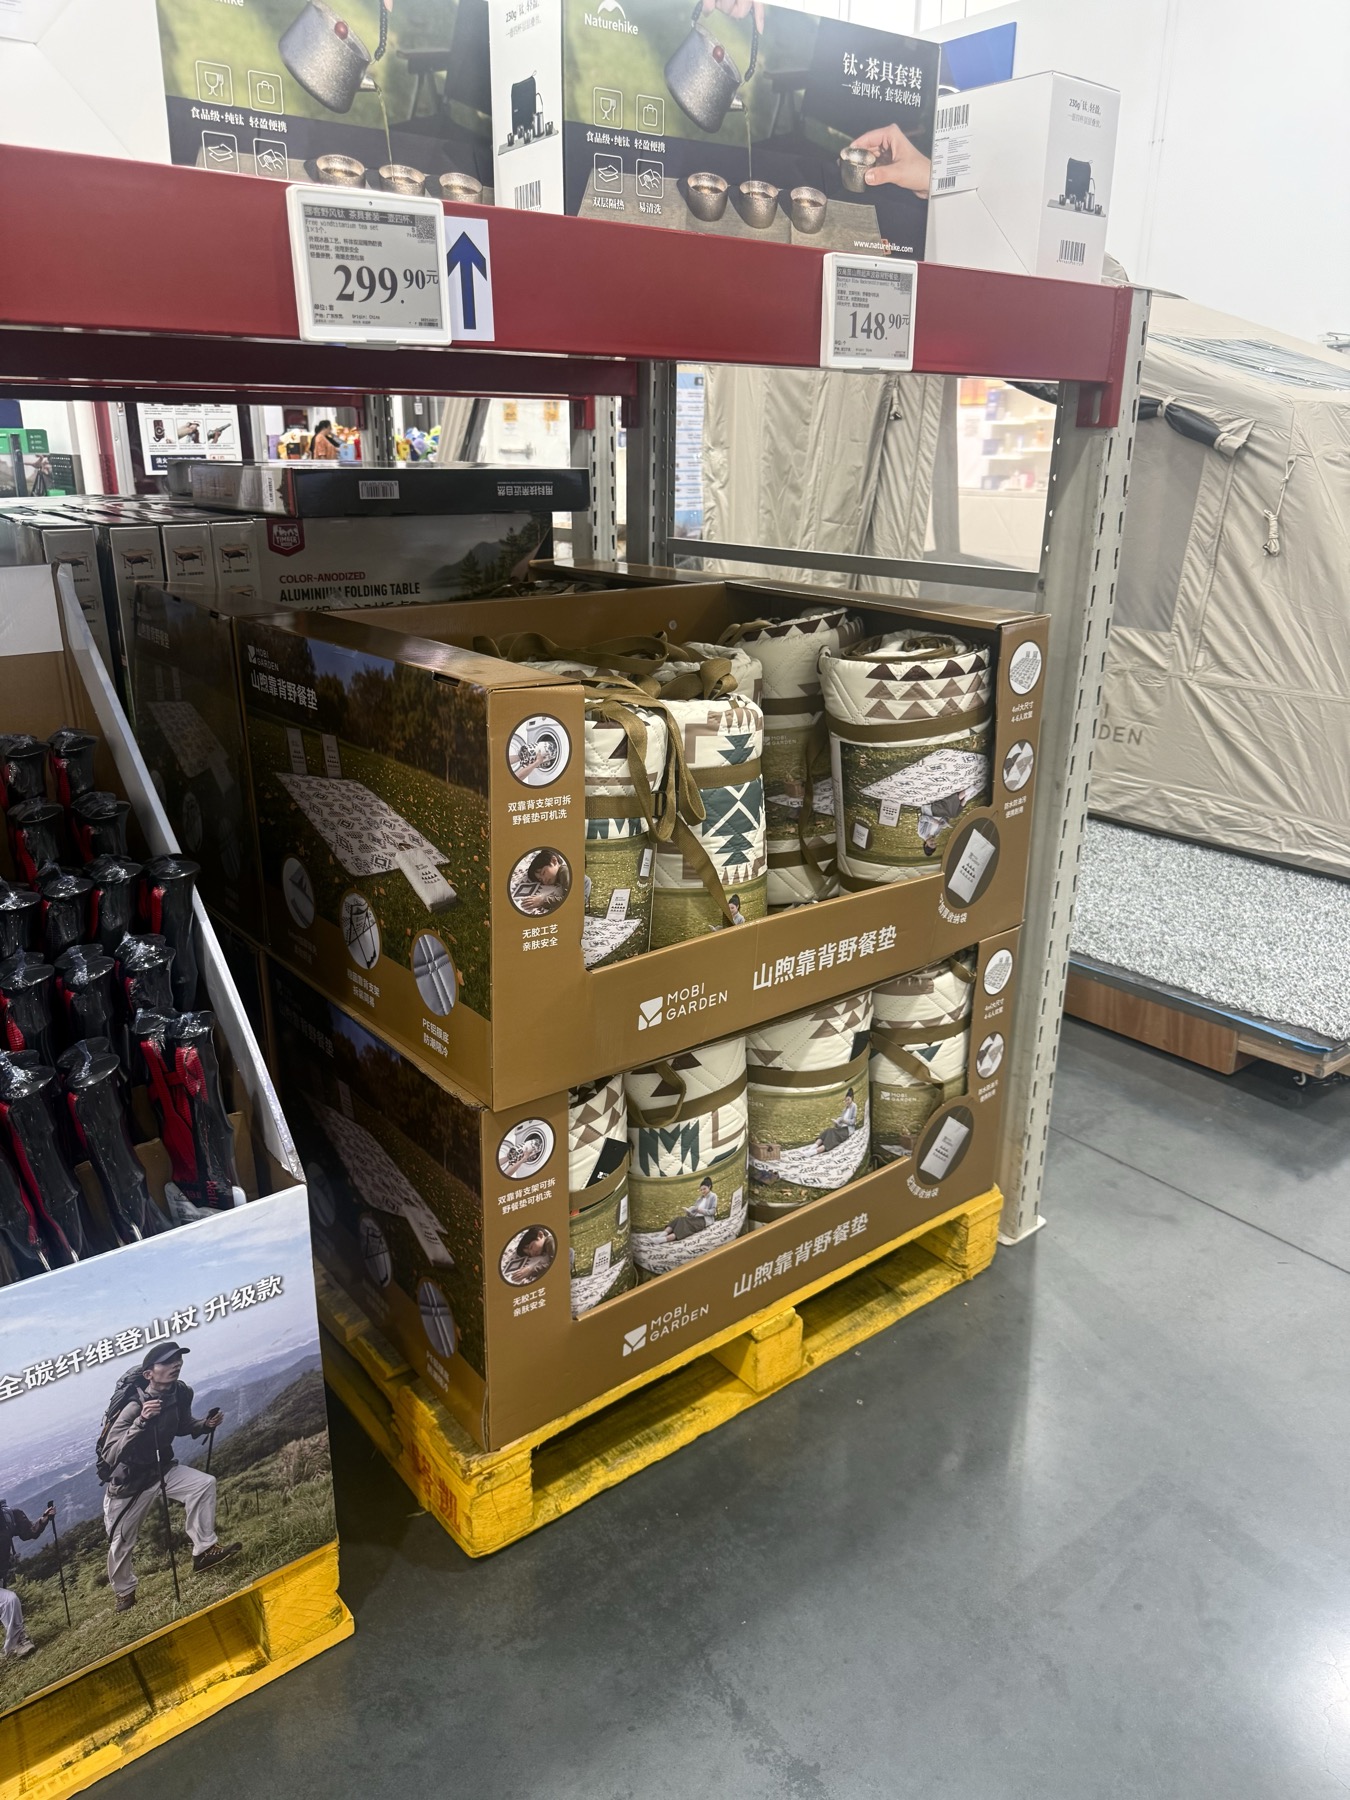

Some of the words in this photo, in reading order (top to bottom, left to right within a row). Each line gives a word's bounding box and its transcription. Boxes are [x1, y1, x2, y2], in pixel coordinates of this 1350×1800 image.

[585, 13, 639, 35] Naturehike
[249, 116, 288, 133] 轻盈便携
[634, 138, 666, 153] 轻盈便携
[592, 197, 625, 211] 双层隔热
[638, 202, 662, 215] 易清洗
[853, 240, 914, 253] www.naturehike.com
[279, 571, 366, 584] COLOR-ANODIZED
[344, 584, 388, 598] FOLDING
[389, 582, 421, 596] TABLE
[257, 658, 280, 672] GARDEN
[250, 669, 318, 711] 山煦靠背野餐垫
[1098, 723, 1143, 746] DEN
[507, 794, 572, 813] 双靠背支架可拆
[512, 808, 567, 826] 野餐垫可机洗
[522, 924, 558, 940] 无胶工艺
[522, 936, 559, 952] 亲肤安全
[753, 924, 897, 991] 山煦靠背野餐垫
[667, 982, 706, 1006] MOBI
[666, 990, 729, 1021] GARDEN
[497, 1177, 556, 1206] 双靠背支架可拆
[502, 1190, 553, 1215] 野餐垫可机洗
[733, 1212, 869, 1299] 山煦靠背野餐垫
[512, 1287, 546, 1307] 无胶工艺
[513, 1298, 547, 1318] 亲肤安全
[650, 1303, 688, 1331] MOBI
[649, 1303, 710, 1343] GARDEN
[0, 1305, 199, 1401] 全碳纤维登山杖
[203, 1275, 284, 1323] 升级款
